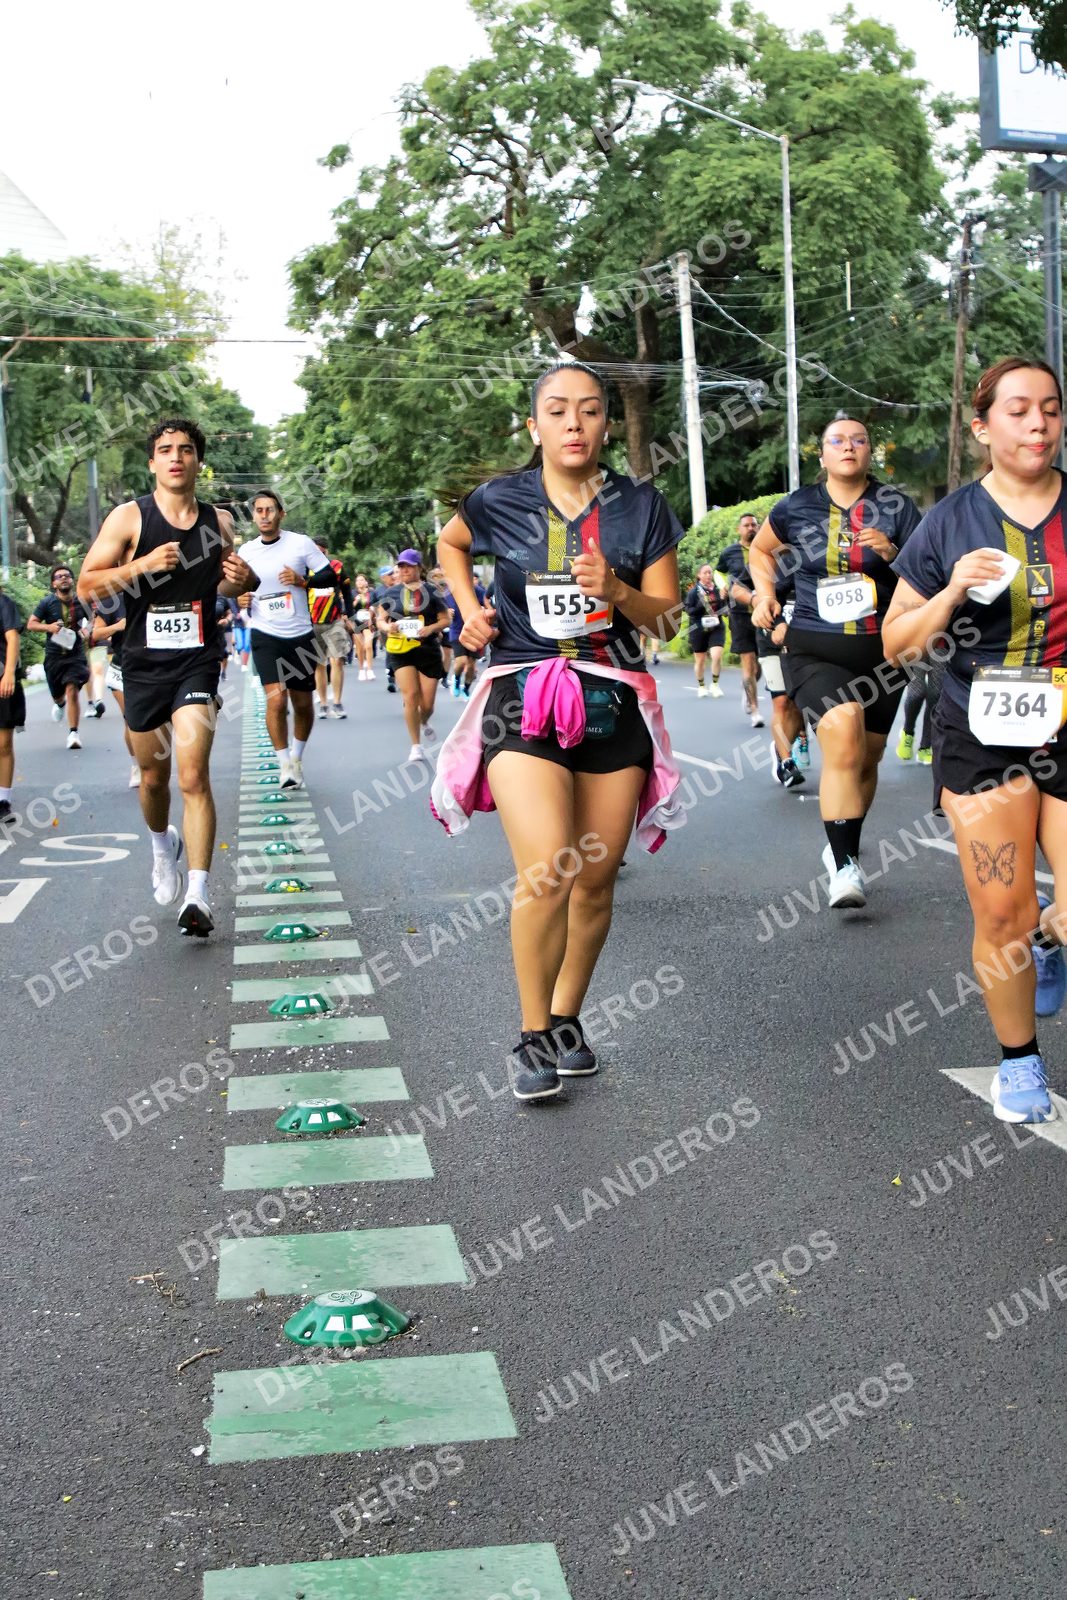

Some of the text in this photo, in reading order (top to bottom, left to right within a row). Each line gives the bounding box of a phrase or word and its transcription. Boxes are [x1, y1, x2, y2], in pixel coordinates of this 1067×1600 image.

[269, 601, 285, 610] 806
[538, 593, 597, 616] 1555
[826, 588, 864, 607] 6958
[154, 618, 191, 633] 8453
[982, 692, 1047, 718] 7364
